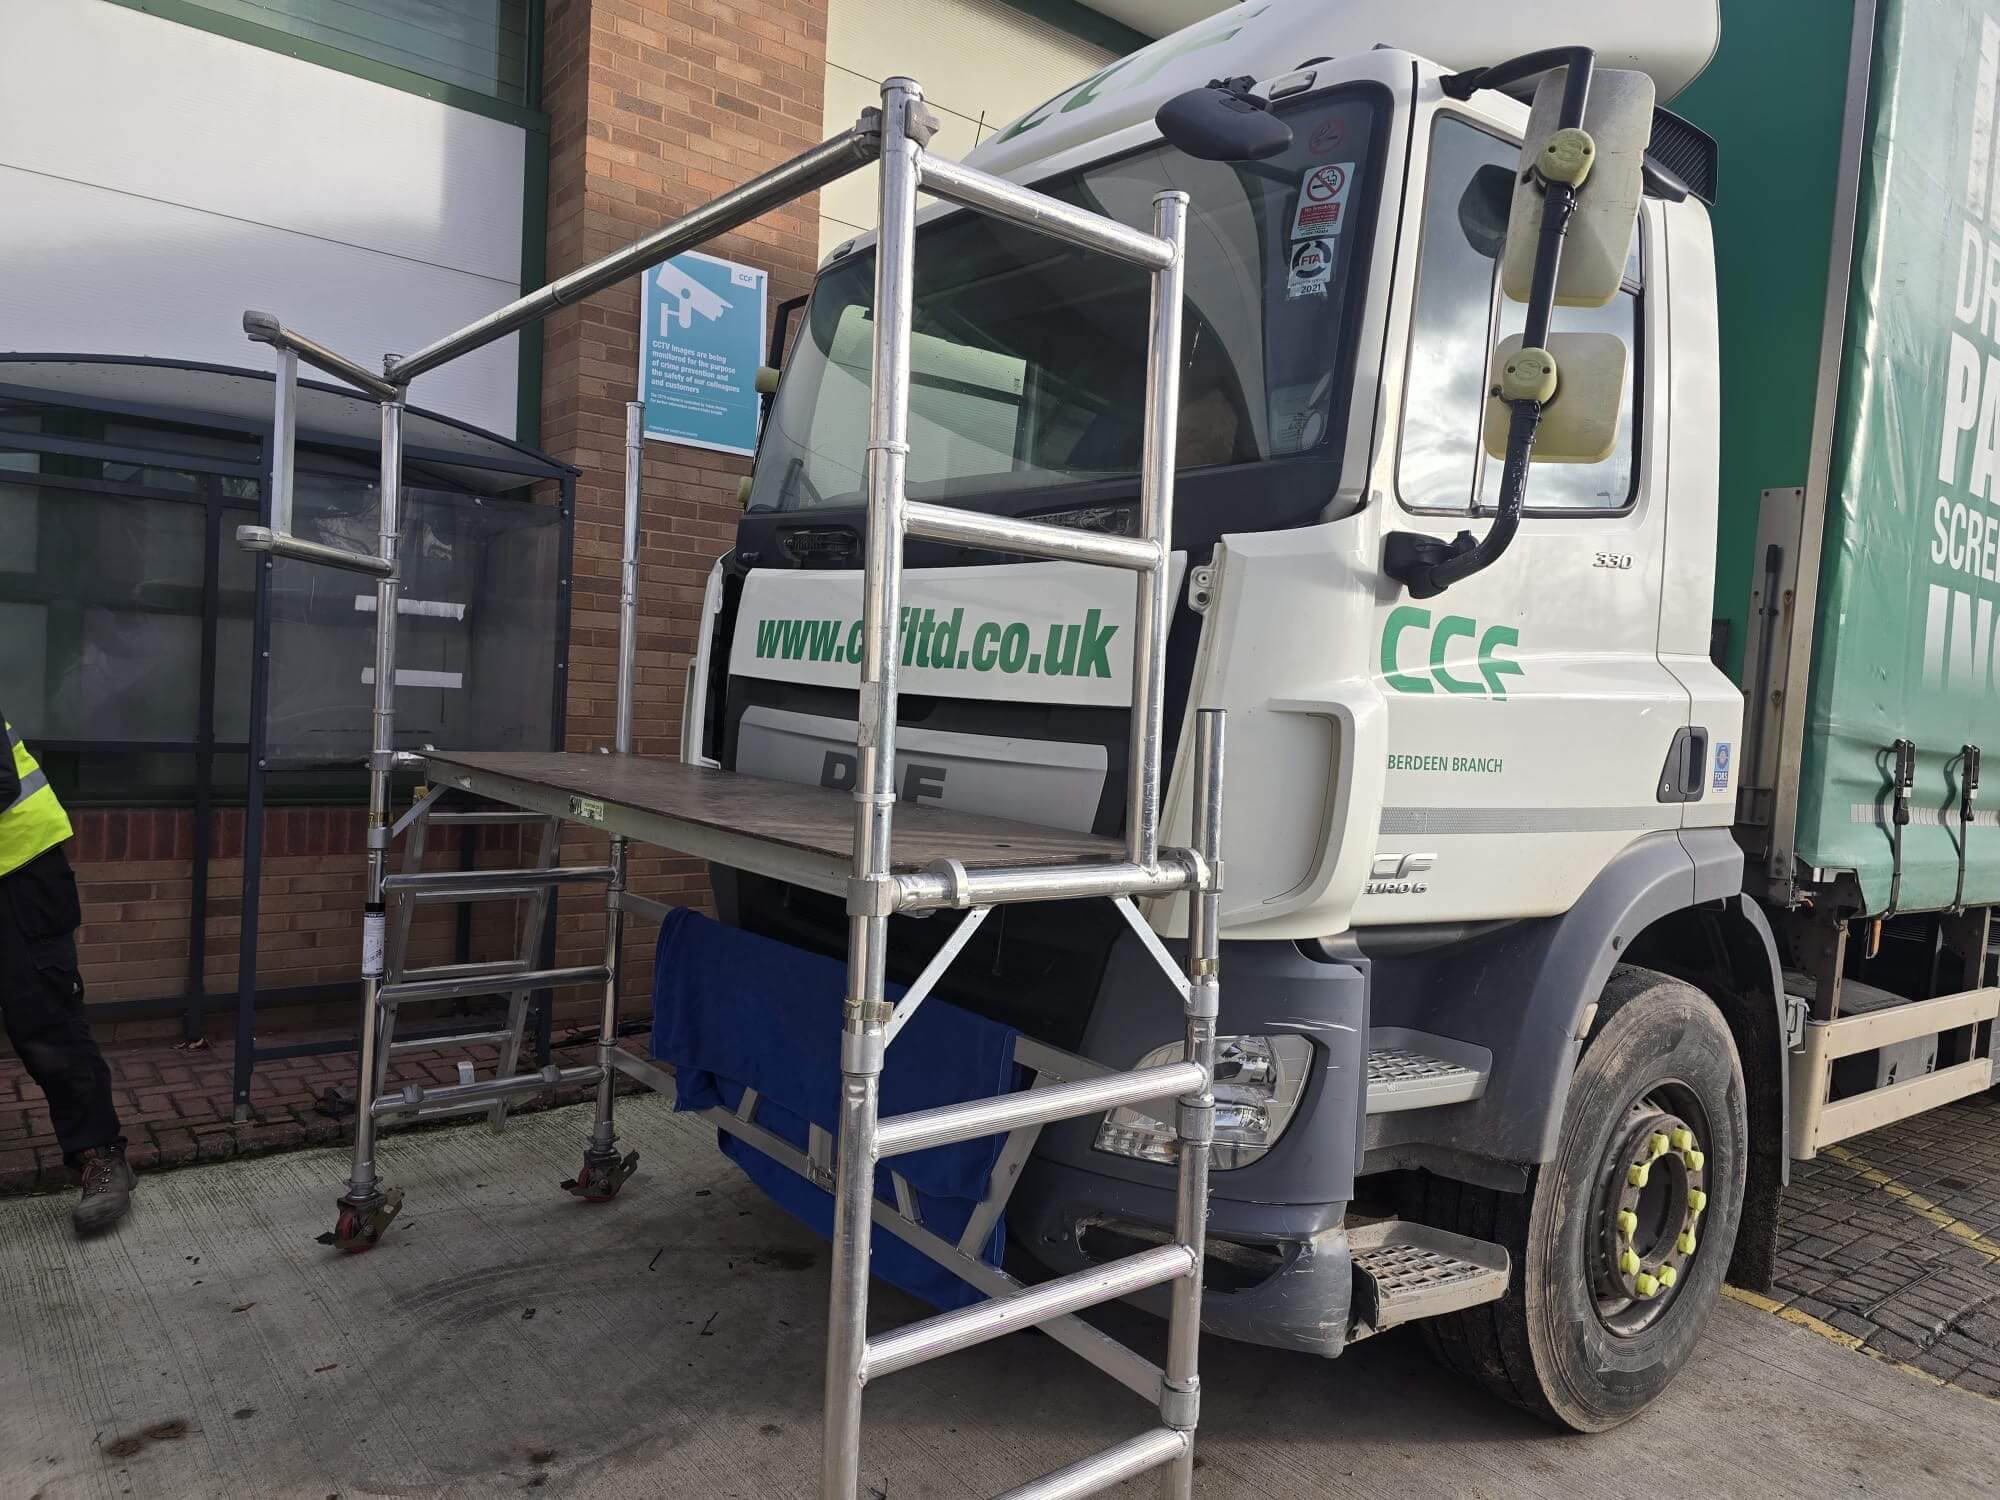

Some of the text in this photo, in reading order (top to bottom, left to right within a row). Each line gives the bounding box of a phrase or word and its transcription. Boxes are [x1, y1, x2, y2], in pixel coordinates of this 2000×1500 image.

[1301, 254, 1321, 266] FTA
[1301, 284, 1321, 294] 2021
[652, 340, 727, 364] CCTV images are being
[652, 350, 686, 363] monitored
[698, 359, 709, 368] the
[710, 363, 736, 374] purpose
[651, 368, 662, 376] the
[664, 371, 684, 383] safety
[707, 380, 740, 393] colleagues
[661, 362, 680, 371] crime
[681, 366, 715, 379] prevention
[716, 374, 729, 382] and
[651, 378, 700, 394] and customers
[1931, 495, 2000, 584] SCRE
[1592, 552, 1634, 569] 330
[1921, 583, 2000, 696] IN
[1380, 606, 1525, 702] CCF
[820, 750, 946, 802] DF
[1452, 756, 1503, 772] BRANCH
[1369, 852, 1438, 879] CF
